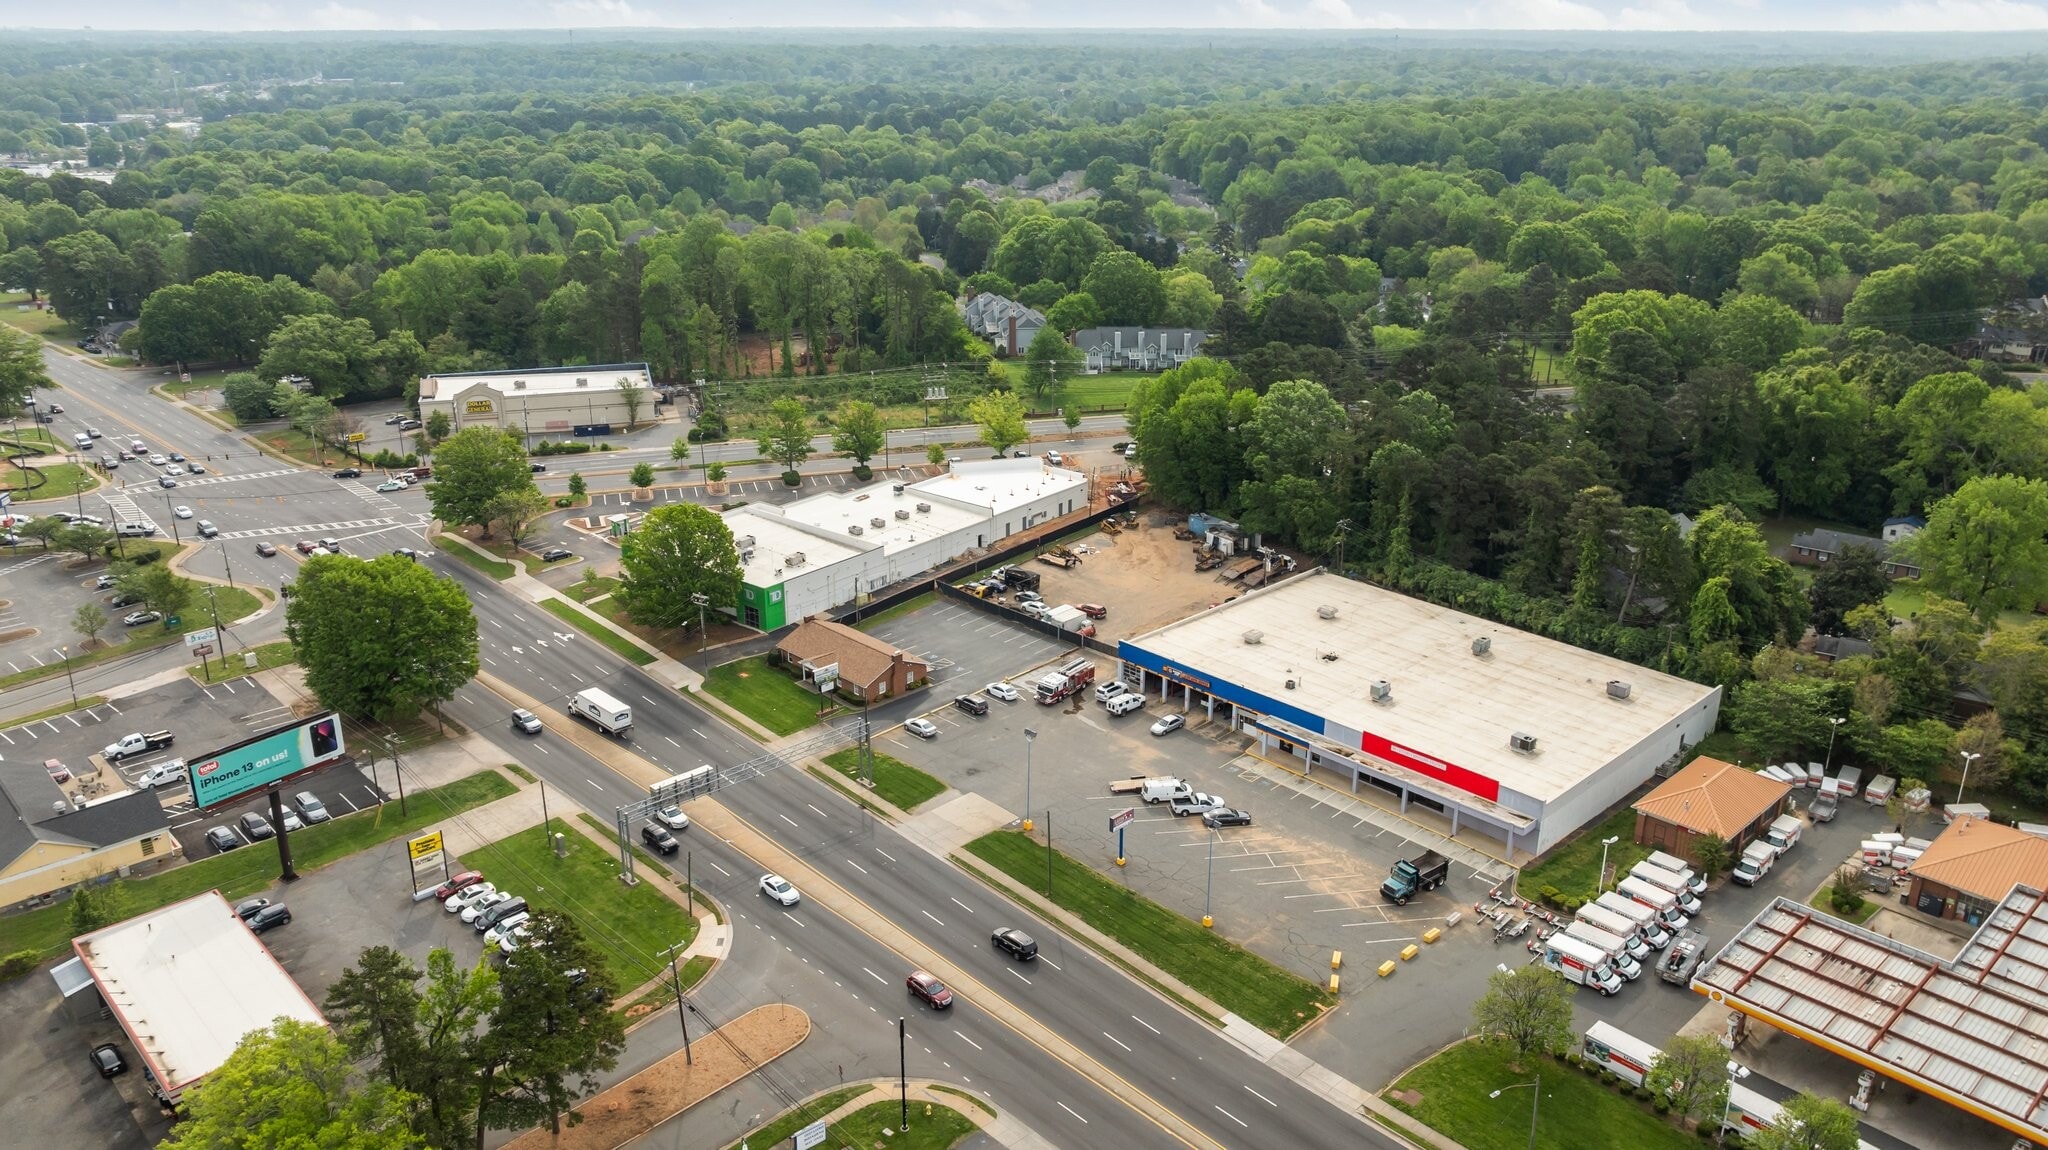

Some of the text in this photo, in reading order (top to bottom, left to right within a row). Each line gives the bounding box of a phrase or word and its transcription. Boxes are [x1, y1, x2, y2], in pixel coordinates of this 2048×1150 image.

[769, 590, 781, 602] TD
[200, 768, 240, 789] iPhone
[242, 762, 254, 772] 13
[256, 758, 270, 768] on
[271, 749, 288, 762] us!
